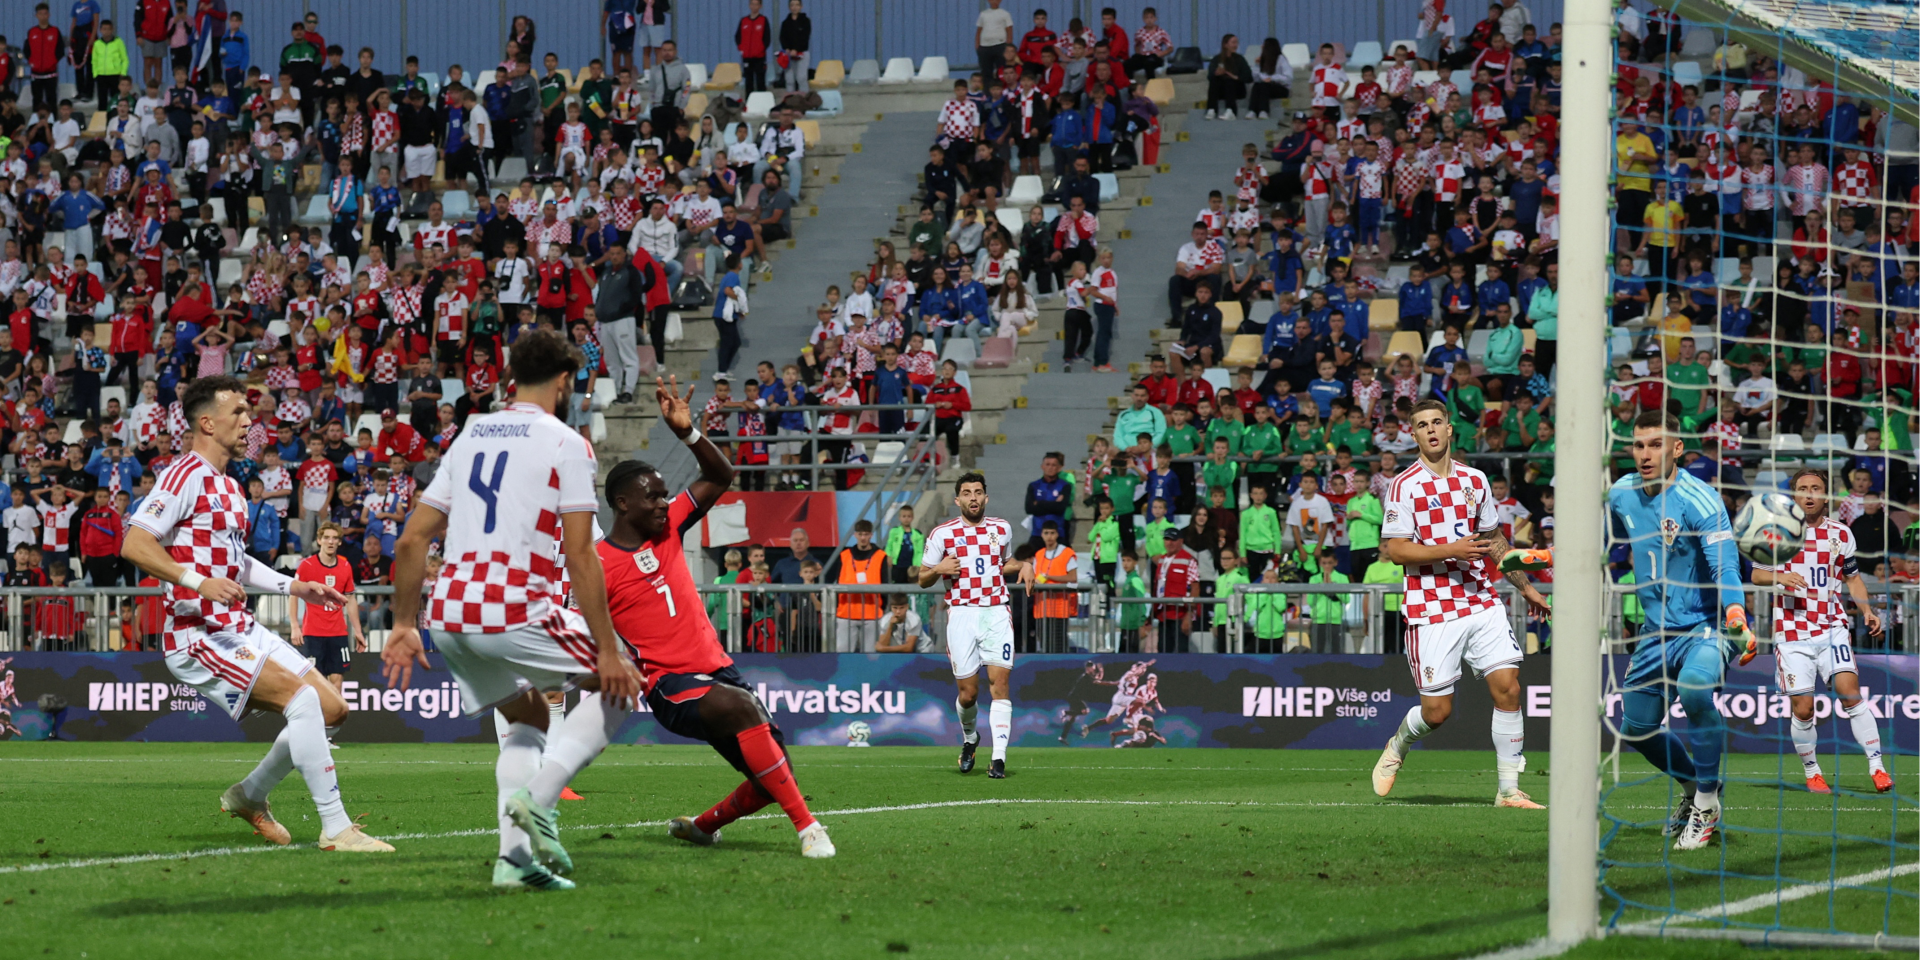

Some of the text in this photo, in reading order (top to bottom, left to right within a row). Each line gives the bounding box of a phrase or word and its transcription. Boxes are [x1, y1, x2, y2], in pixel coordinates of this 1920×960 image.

[468, 450, 509, 534] 4
[975, 557, 985, 575] 8
[1647, 550, 1657, 580] 1
[1810, 566, 1827, 588] 10
[656, 583, 677, 618] 7
[340, 646, 350, 662] 11
[1002, 643, 1011, 661] 8
[1831, 643, 1851, 664] 10
[115, 682, 197, 711] HEP Više
[170, 698, 206, 714] struje
[341, 681, 466, 719] Energij
[1274, 686, 1391, 717] HEP Više od
[1712, 685, 1792, 726] koja
[1335, 703, 1378, 720] struje
